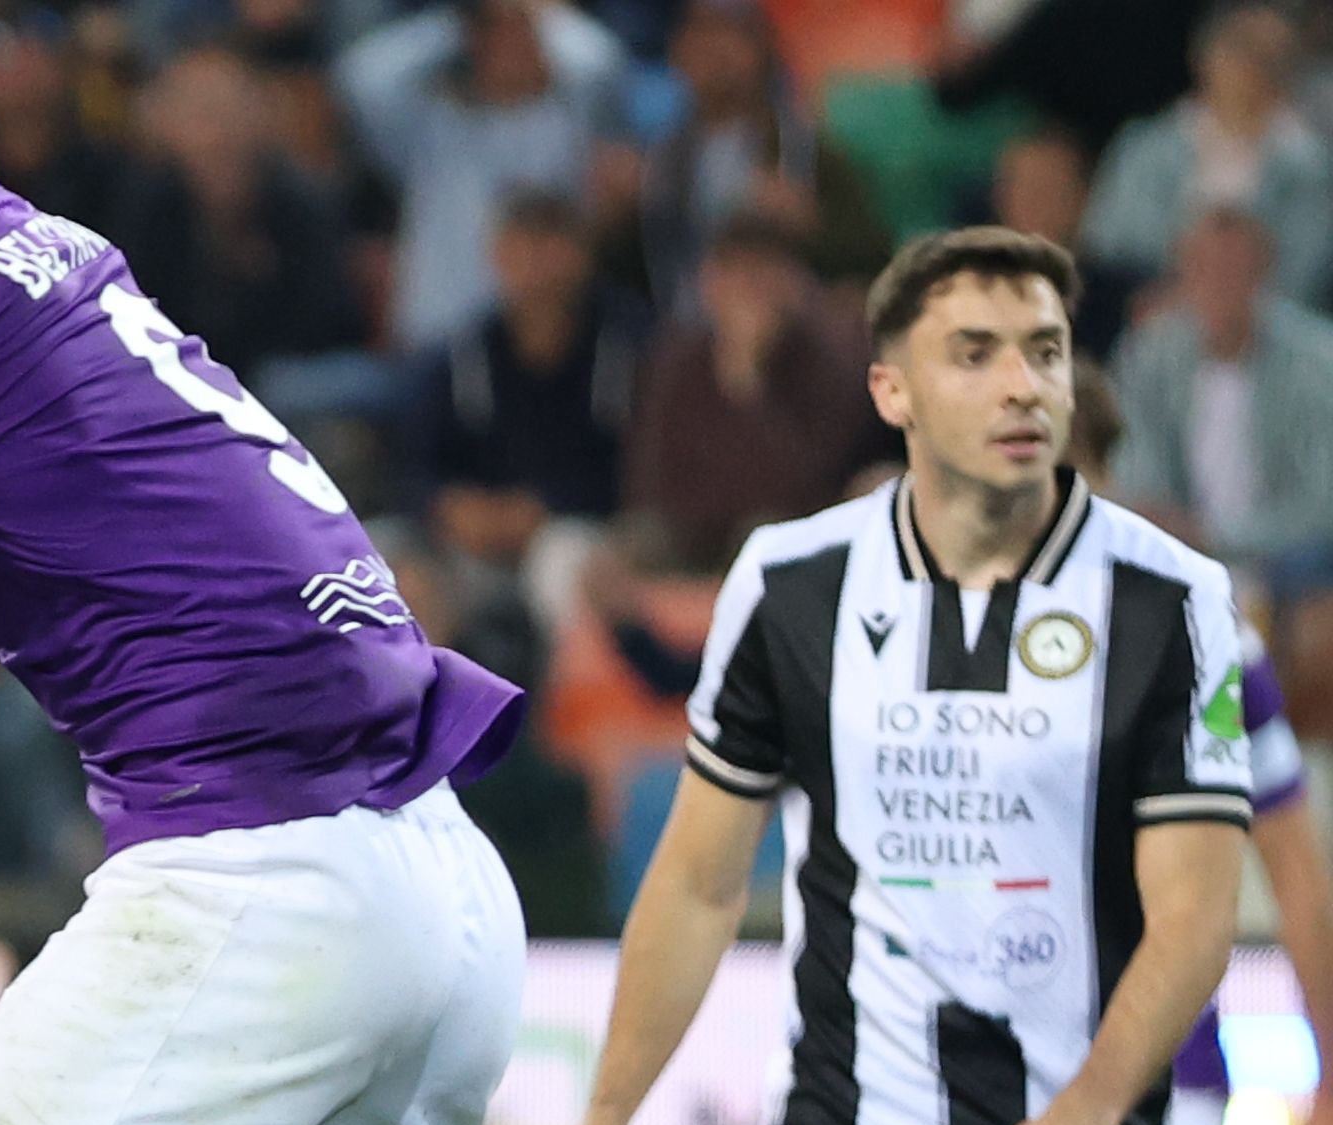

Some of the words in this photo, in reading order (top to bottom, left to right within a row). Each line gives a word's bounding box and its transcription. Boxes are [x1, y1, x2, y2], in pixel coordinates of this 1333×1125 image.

[876, 702, 920, 733] IO
[936, 702, 1051, 739] SONO
[876, 743, 980, 780] FRIULI
[876, 786, 1036, 823] VENEZIA
[876, 831, 1002, 867] GIULIA
